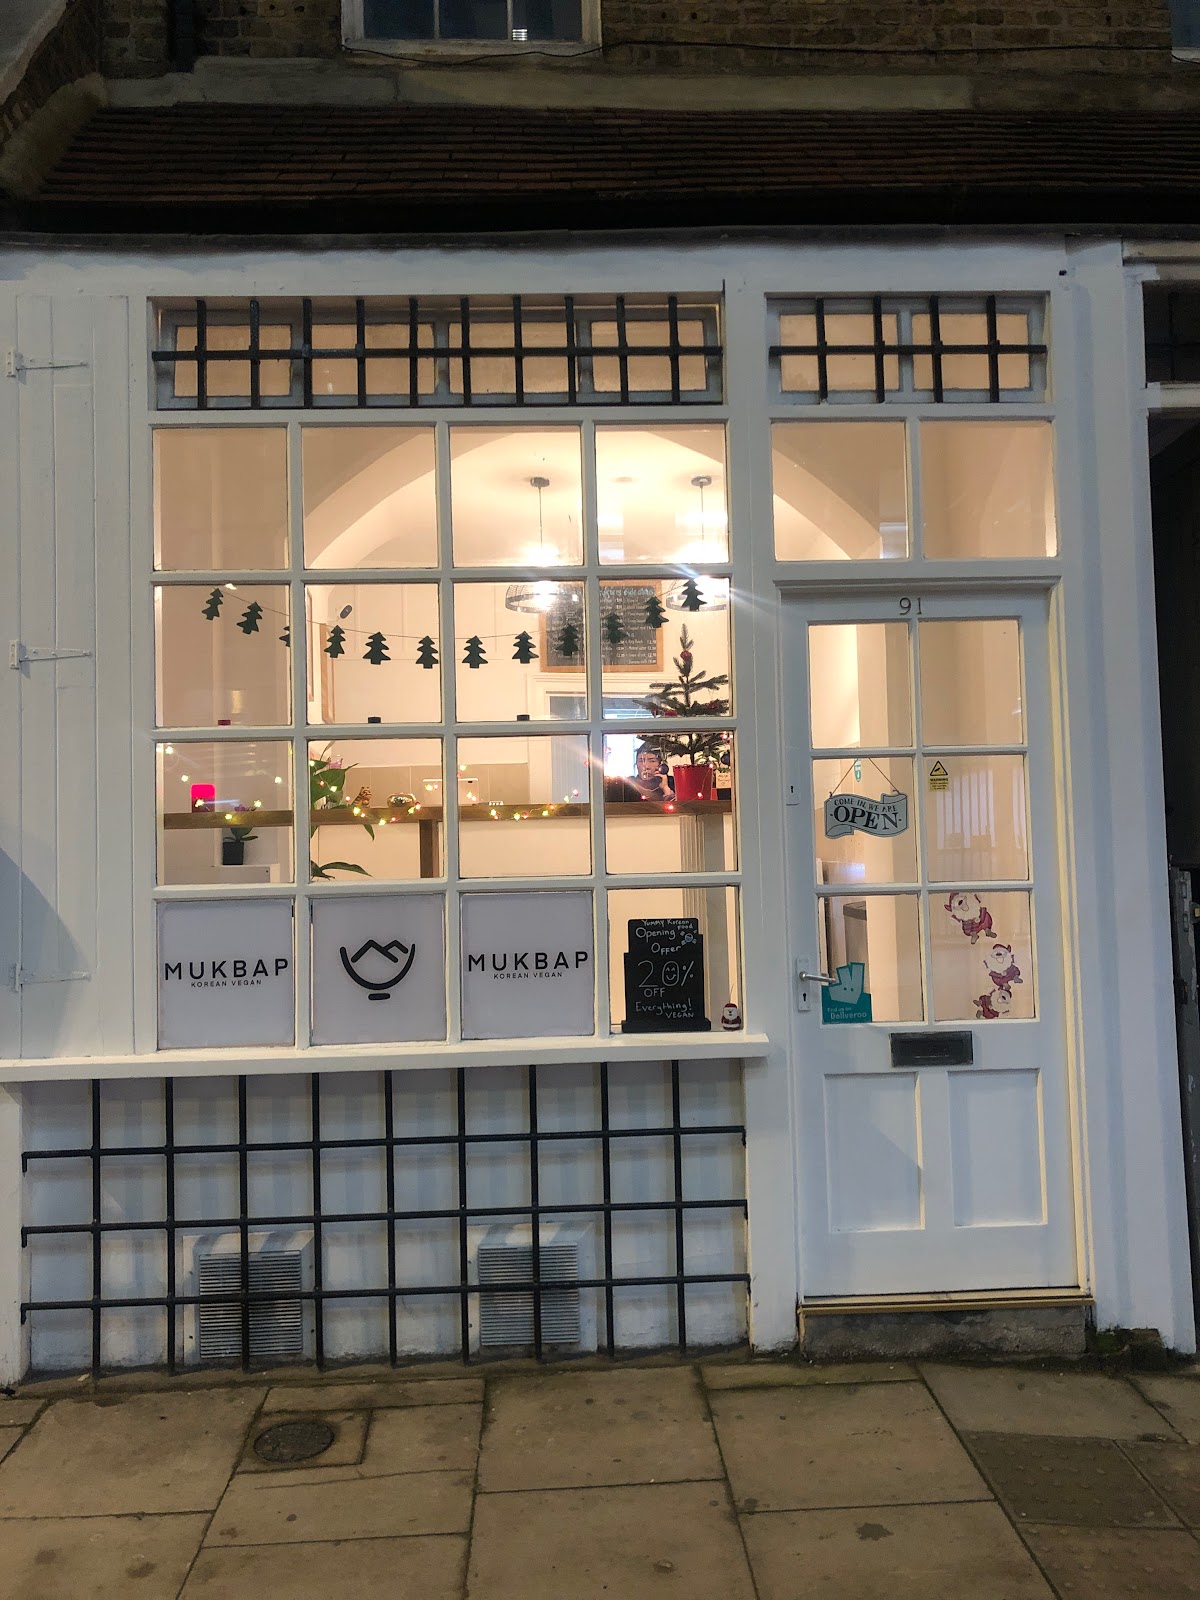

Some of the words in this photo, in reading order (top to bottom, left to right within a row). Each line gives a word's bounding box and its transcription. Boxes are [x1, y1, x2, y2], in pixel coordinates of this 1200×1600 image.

[899, 597, 923, 616] 91
[834, 797, 855, 807] COME
[868, 803, 880, 812] WE
[881, 804, 898, 813] ARE
[833, 805, 899, 831] OPEN
[635, 927, 676, 943] Opening
[164, 958, 289, 981] MUKBAP
[468, 951, 589, 972] MUKBAP
[493, 972, 529, 980] KOREAN
[533, 971, 563, 979] VEGAN
[637, 960, 695, 988] 20%
[643, 987, 666, 998] OFF
[665, 1011, 695, 1019] VEGAN
[830, 1011, 867, 1020] Deliveroo
